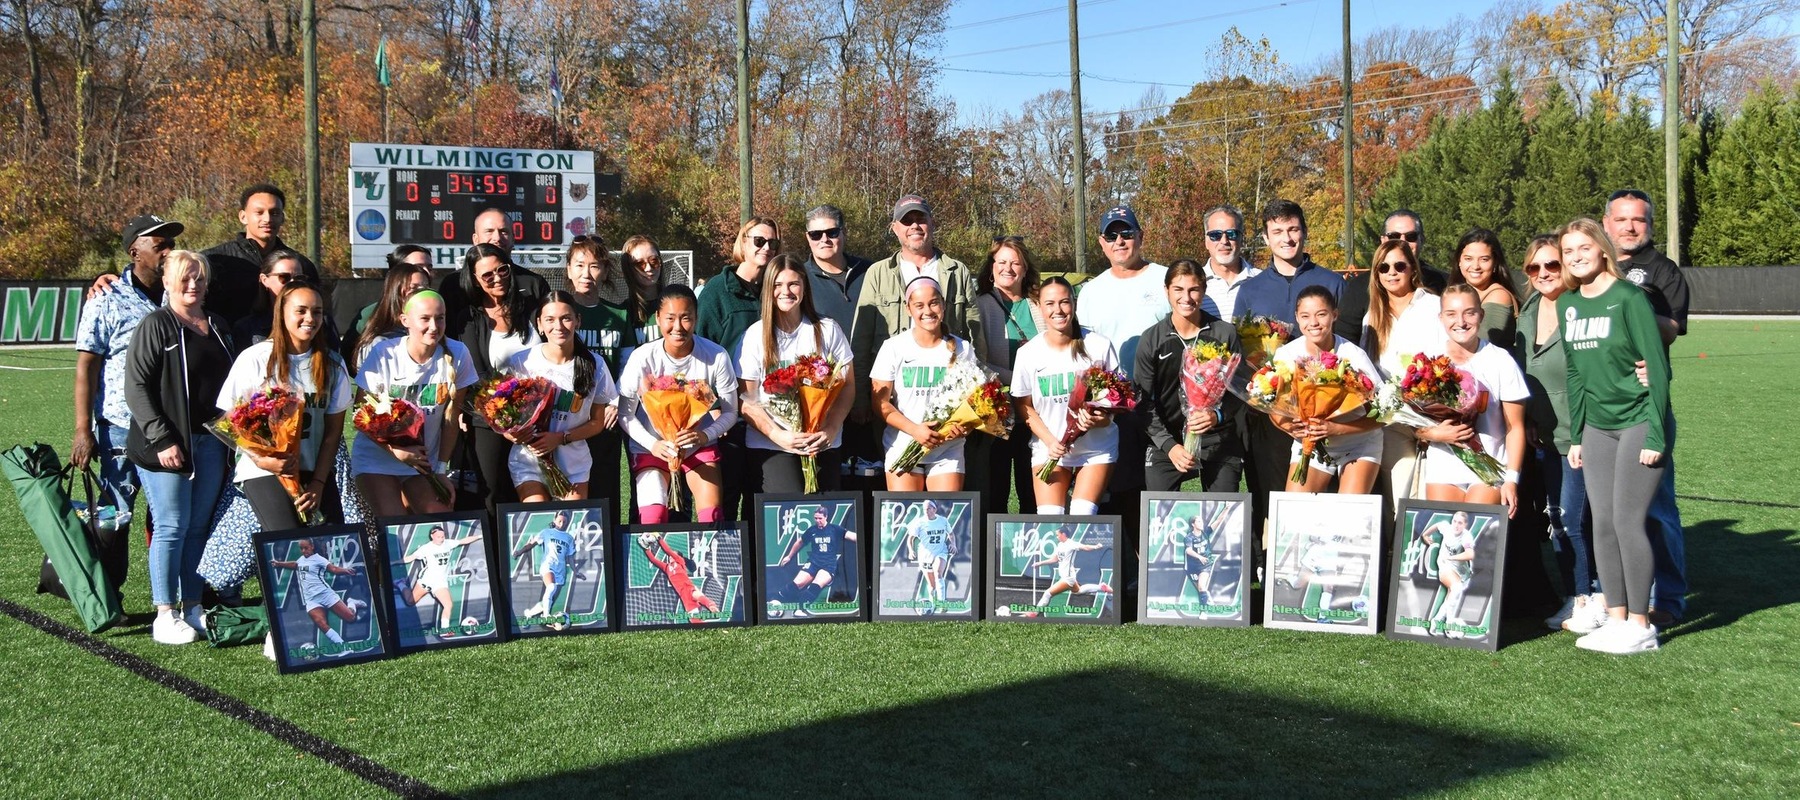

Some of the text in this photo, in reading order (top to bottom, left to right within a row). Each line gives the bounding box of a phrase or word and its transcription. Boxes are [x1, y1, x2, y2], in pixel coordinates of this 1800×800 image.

[374, 147, 574, 170] WILMINGTON
[396, 170, 418, 182] HOME
[450, 174, 508, 193] 34:55
[535, 174, 557, 187] GUEST
[406, 182, 419, 202] 0
[545, 186, 556, 204] 0
[396, 209, 420, 221] PENALTY
[434, 210, 453, 221] SHOTS
[506, 211, 522, 222] OTS
[535, 211, 557, 222] PENALTY
[443, 221, 454, 239] 0
[513, 222, 524, 240] 0
[541, 222, 553, 240] 0
[1566, 316, 1611, 342] WILMU
[1573, 341, 1598, 350] SOCCER
[901, 366, 947, 388] WILM
[1053, 396, 1068, 404] SOC
[783, 508, 812, 535] #5
[568, 520, 603, 552] #2
[929, 536, 941, 544] 22
[1012, 528, 1057, 558] #26
[691, 536, 719, 578] #1
[1010, 603, 1059, 614] Brianna
[1273, 604, 1309, 616] Alexa
[637, 612, 662, 622] Mio
[1396, 615, 1430, 629] Julia
